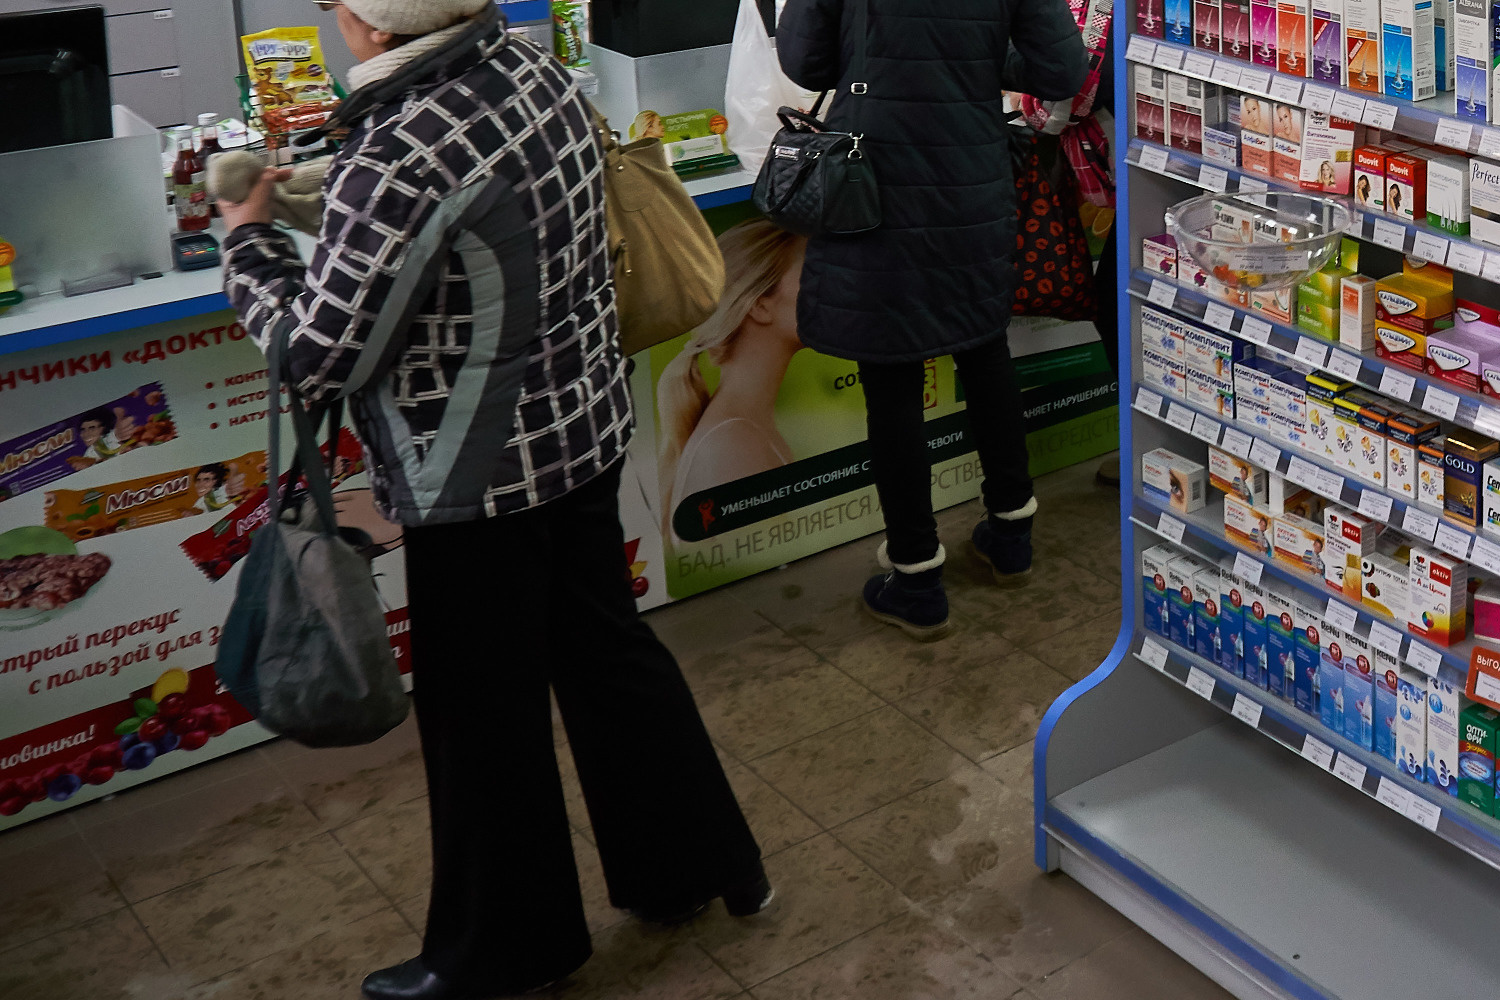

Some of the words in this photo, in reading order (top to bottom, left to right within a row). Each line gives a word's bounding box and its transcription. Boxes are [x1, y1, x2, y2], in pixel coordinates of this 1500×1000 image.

[1458, 0, 1483, 10] ALERANA
[1389, 165, 1409, 177] Duovit
[1053, 386, 1108, 412] НАРУШЕНИЯ
[926, 431, 964, 450] ЕВОГИ
[1445, 454, 1475, 475] GOLD
[105, 474, 189, 516] Мюсли
[720, 485, 791, 516] УМЕНЬШАЕТ
[793, 463, 859, 494] СОСТОЯНИЕ
[677, 548, 732, 579] БАД.
[734, 534, 765, 560] НЕ
[768, 494, 873, 550] ЯВЛЯЕТСЯ
[85, 609, 181, 650] перекус
[28, 679, 40, 694] с
[47, 643, 150, 690] пользой
[155, 630, 202, 661] для
